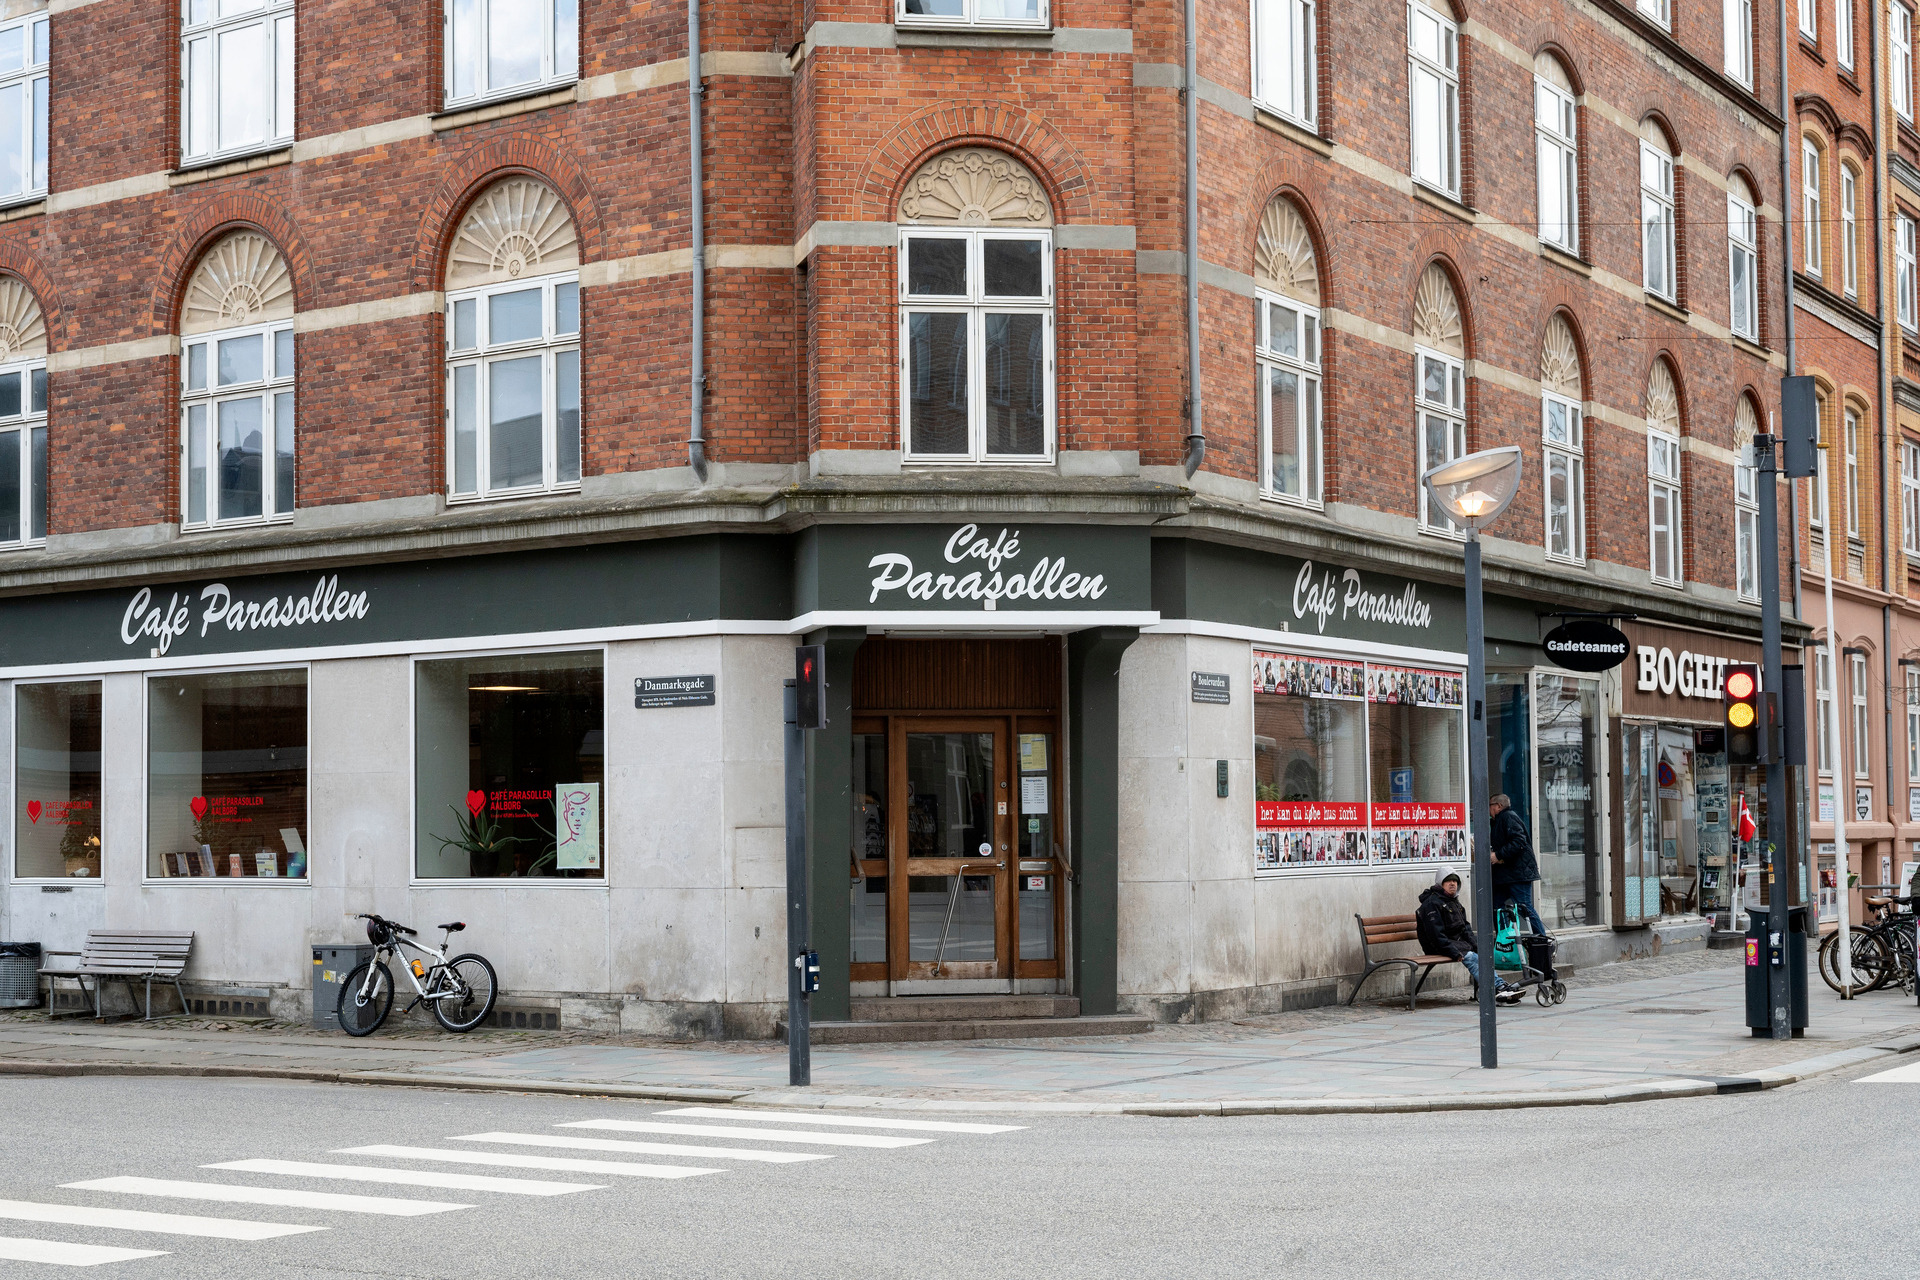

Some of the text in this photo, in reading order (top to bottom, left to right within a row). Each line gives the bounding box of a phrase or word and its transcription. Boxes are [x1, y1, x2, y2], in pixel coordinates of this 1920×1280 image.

[944, 523, 1020, 571] Café
[868, 553, 1108, 603] Parasollen
[1293, 560, 1432, 634] Café Parasollen
[121, 574, 370, 656] Café Parasollen
[1547, 640, 1625, 653] Gadeteamet
[644, 678, 705, 691] Danmarksgade
[490, 789, 552, 800] CAFÉ PARASOLLEN
[1545, 781, 1591, 801] Gadeteamet
[226, 797, 264, 806] PARASOLLEN
[490, 801, 521, 810] AALBORG
[211, 807, 238, 815] AALBORG
[1260, 803, 1358, 823] her kan du købe hus forbi
[1375, 804, 1458, 822] her kan du købe hus forbi
